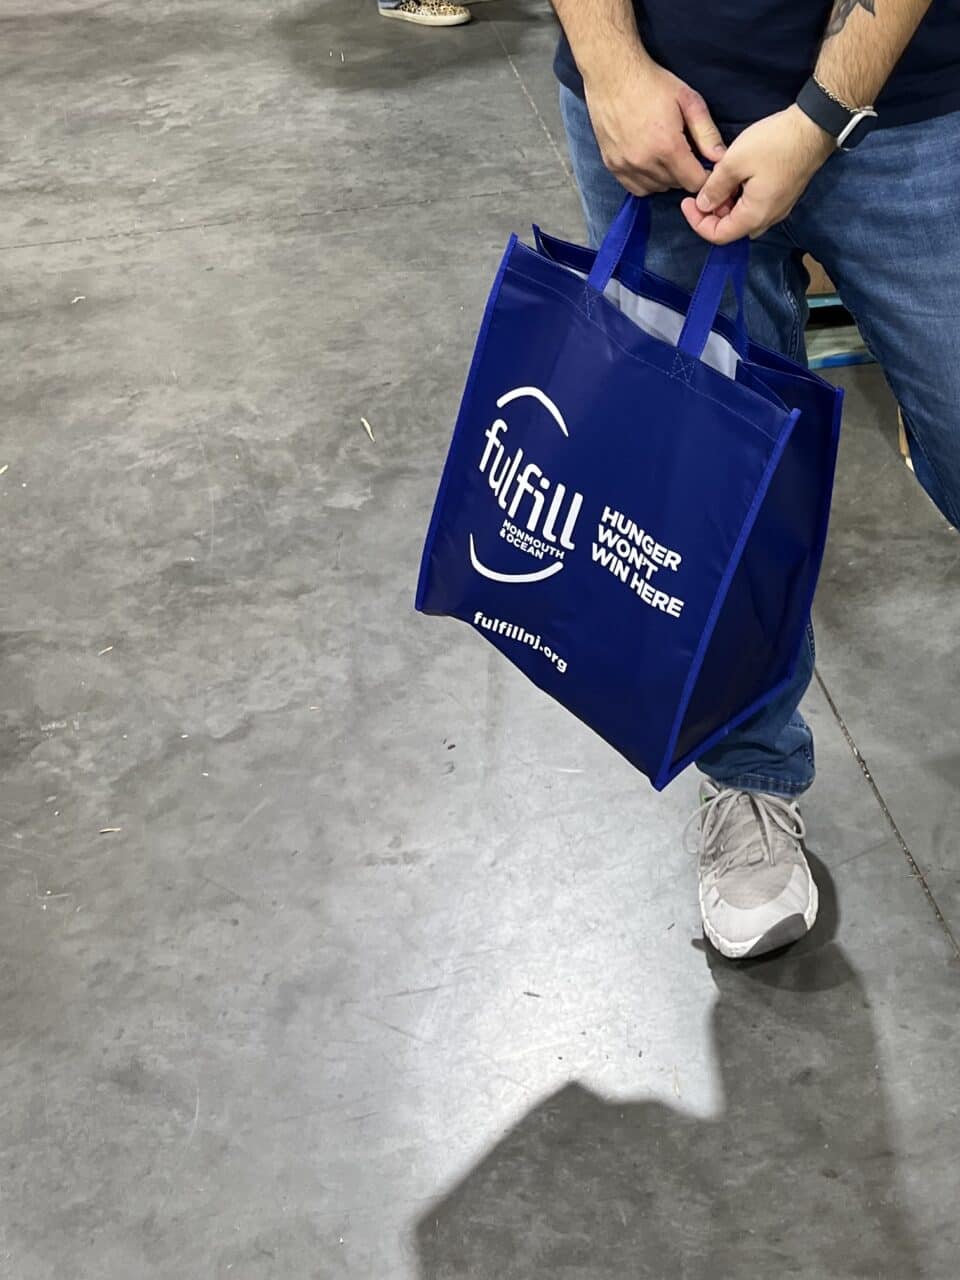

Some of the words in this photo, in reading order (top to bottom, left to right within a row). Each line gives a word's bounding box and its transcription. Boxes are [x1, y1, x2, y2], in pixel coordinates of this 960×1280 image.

[478, 418, 584, 551] fulfill
[501, 519, 565, 560] MONMOUTH
[596, 523, 659, 580] WON'T
[601, 505, 682, 572] HUNGER
[591, 542, 627, 583] WIN
[629, 575, 685, 619] HERE
[472, 610, 569, 674] fulfillnj.org
